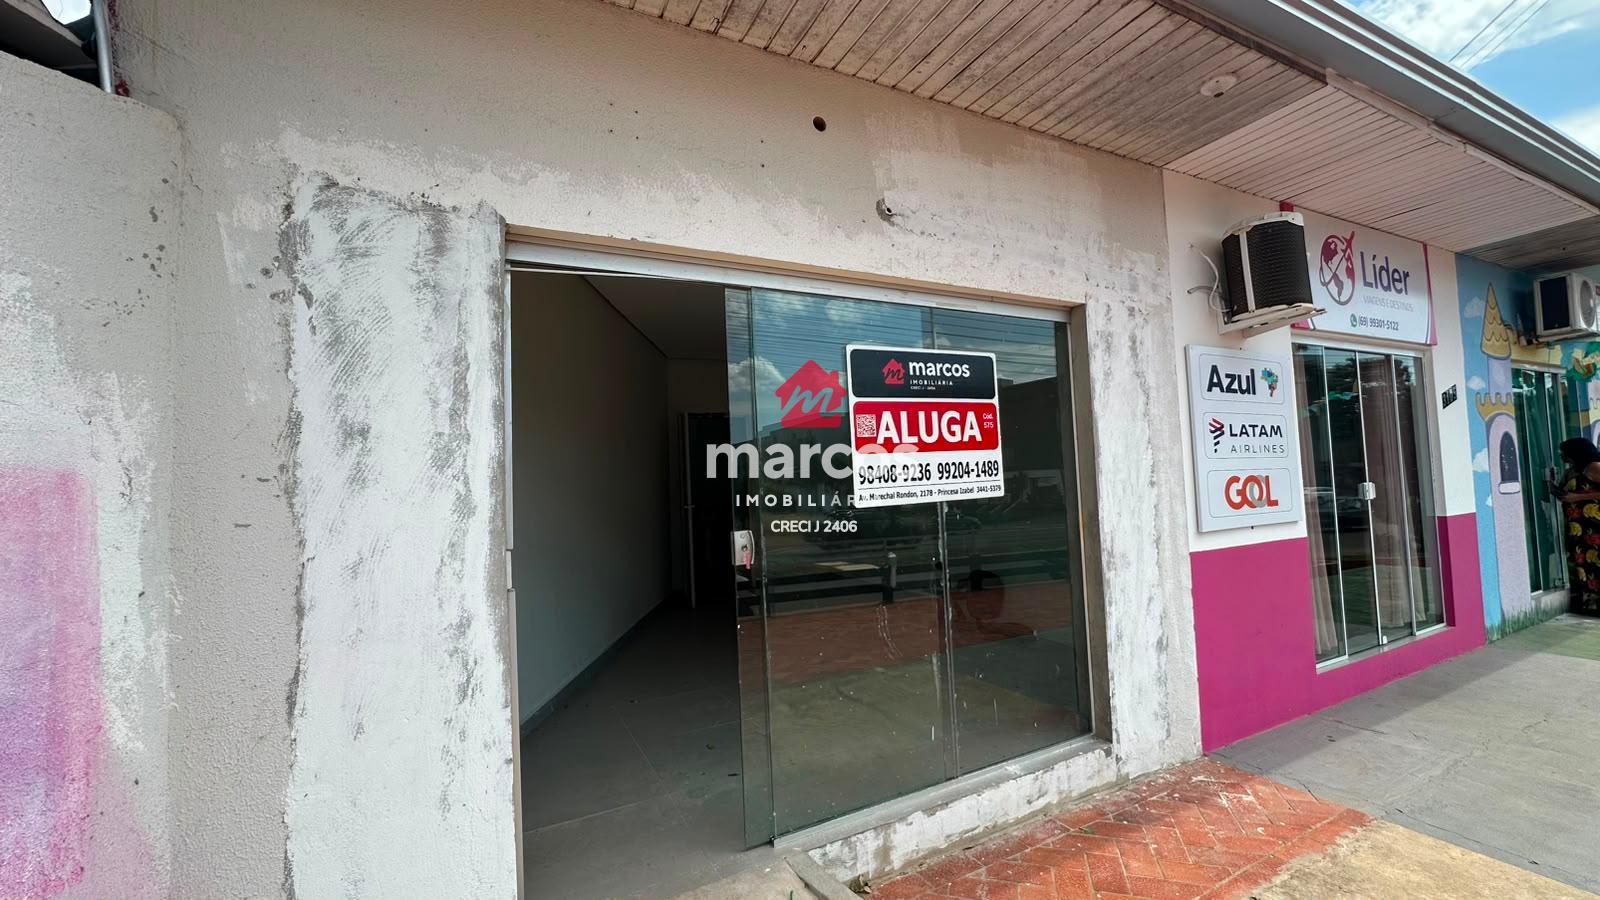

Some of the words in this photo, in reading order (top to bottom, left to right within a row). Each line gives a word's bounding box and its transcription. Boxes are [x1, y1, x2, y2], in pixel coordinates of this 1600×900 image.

[1360, 251, 1410, 295] Líder
[1359, 315, 1368, 327] (69)
[1369, 317, 1399, 331] 99301-5122
[908, 361, 970, 377] marcos
[1207, 364, 1256, 395] Azul
[876, 410, 982, 444] ALUGA
[1229, 423, 1283, 438] LATAM
[1230, 444, 1285, 454] AIRLINES
[858, 463, 931, 485] 98408-9236
[937, 460, 999, 480] 99204-1489
[1224, 475, 1279, 510] GOL
